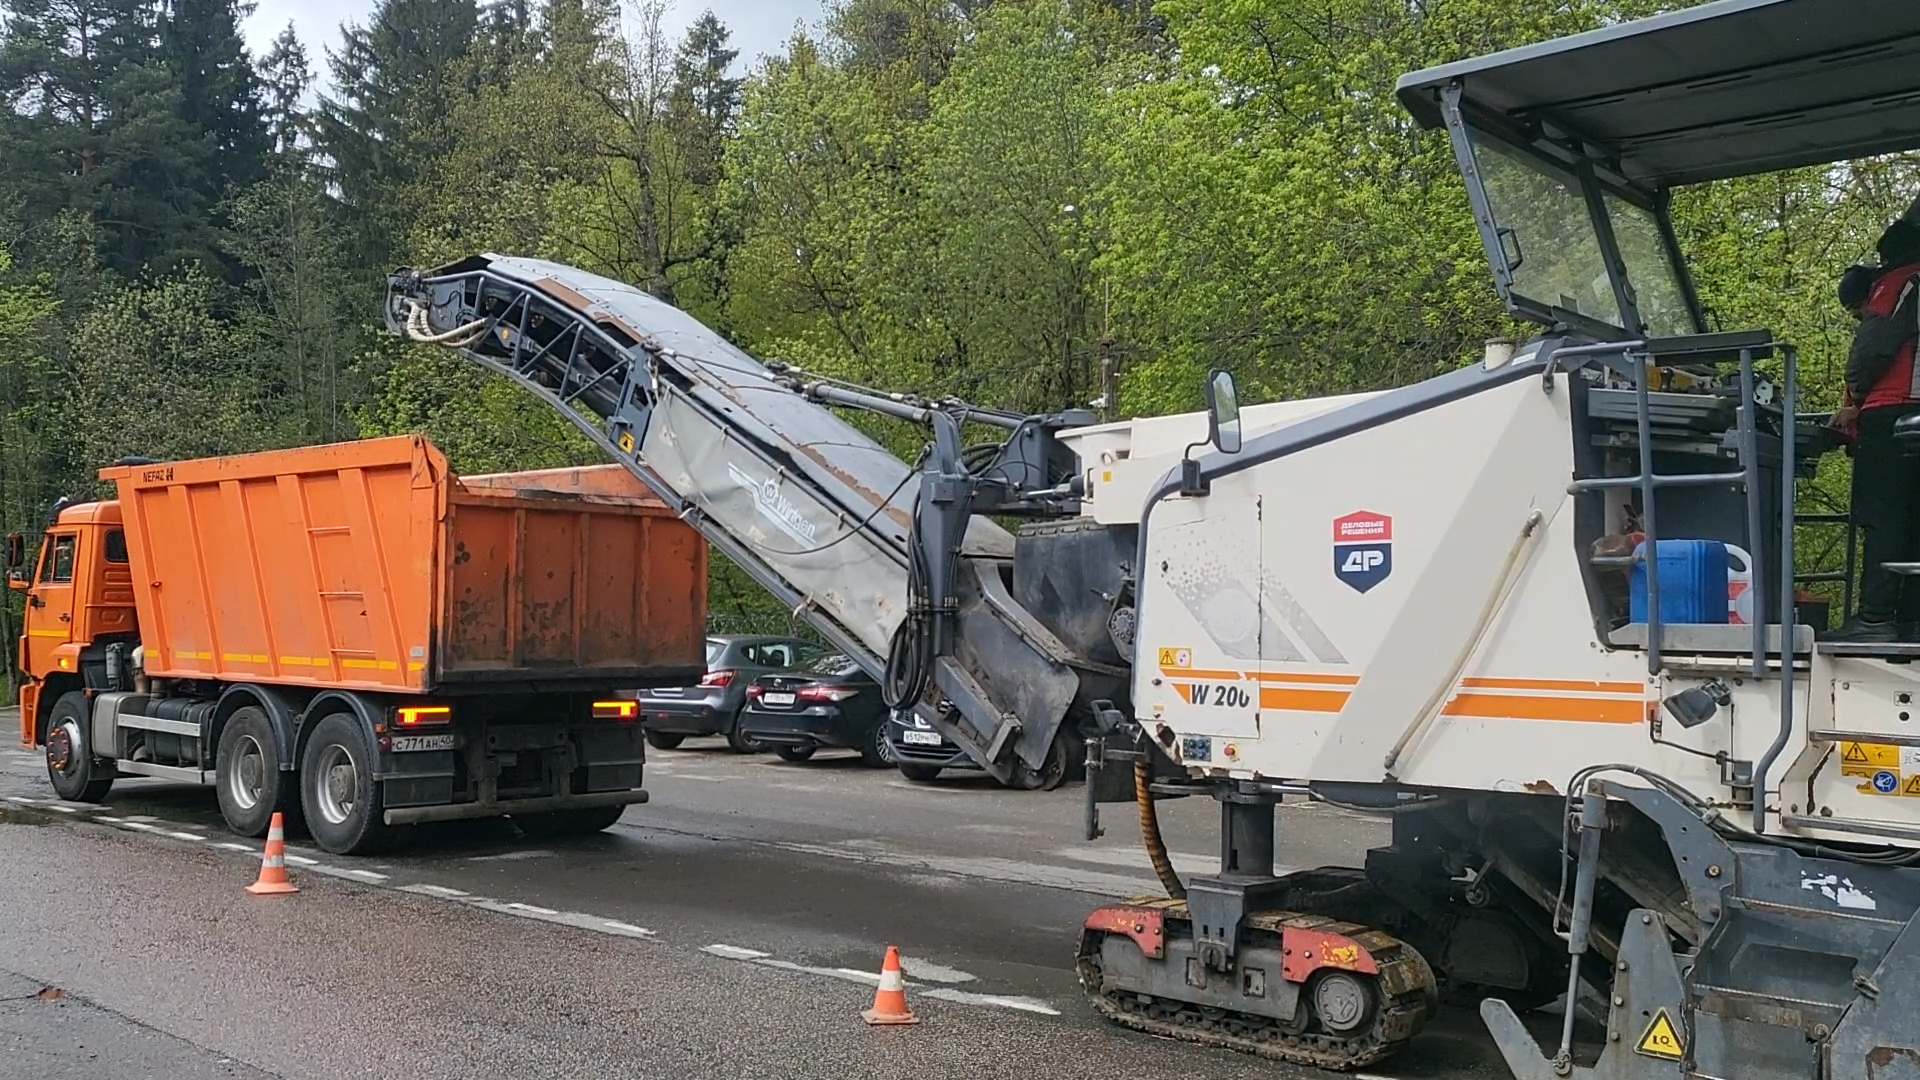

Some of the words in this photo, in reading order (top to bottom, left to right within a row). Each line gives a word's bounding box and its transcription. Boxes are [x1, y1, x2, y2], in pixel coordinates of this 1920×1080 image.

[143, 470, 164, 483] NEFAZ
[777, 494, 816, 538] Wirtgen
[1341, 521, 1384, 529] ДЕЛОВЫЕ
[1341, 550, 1384, 572] ДР
[1191, 684, 1210, 705] W
